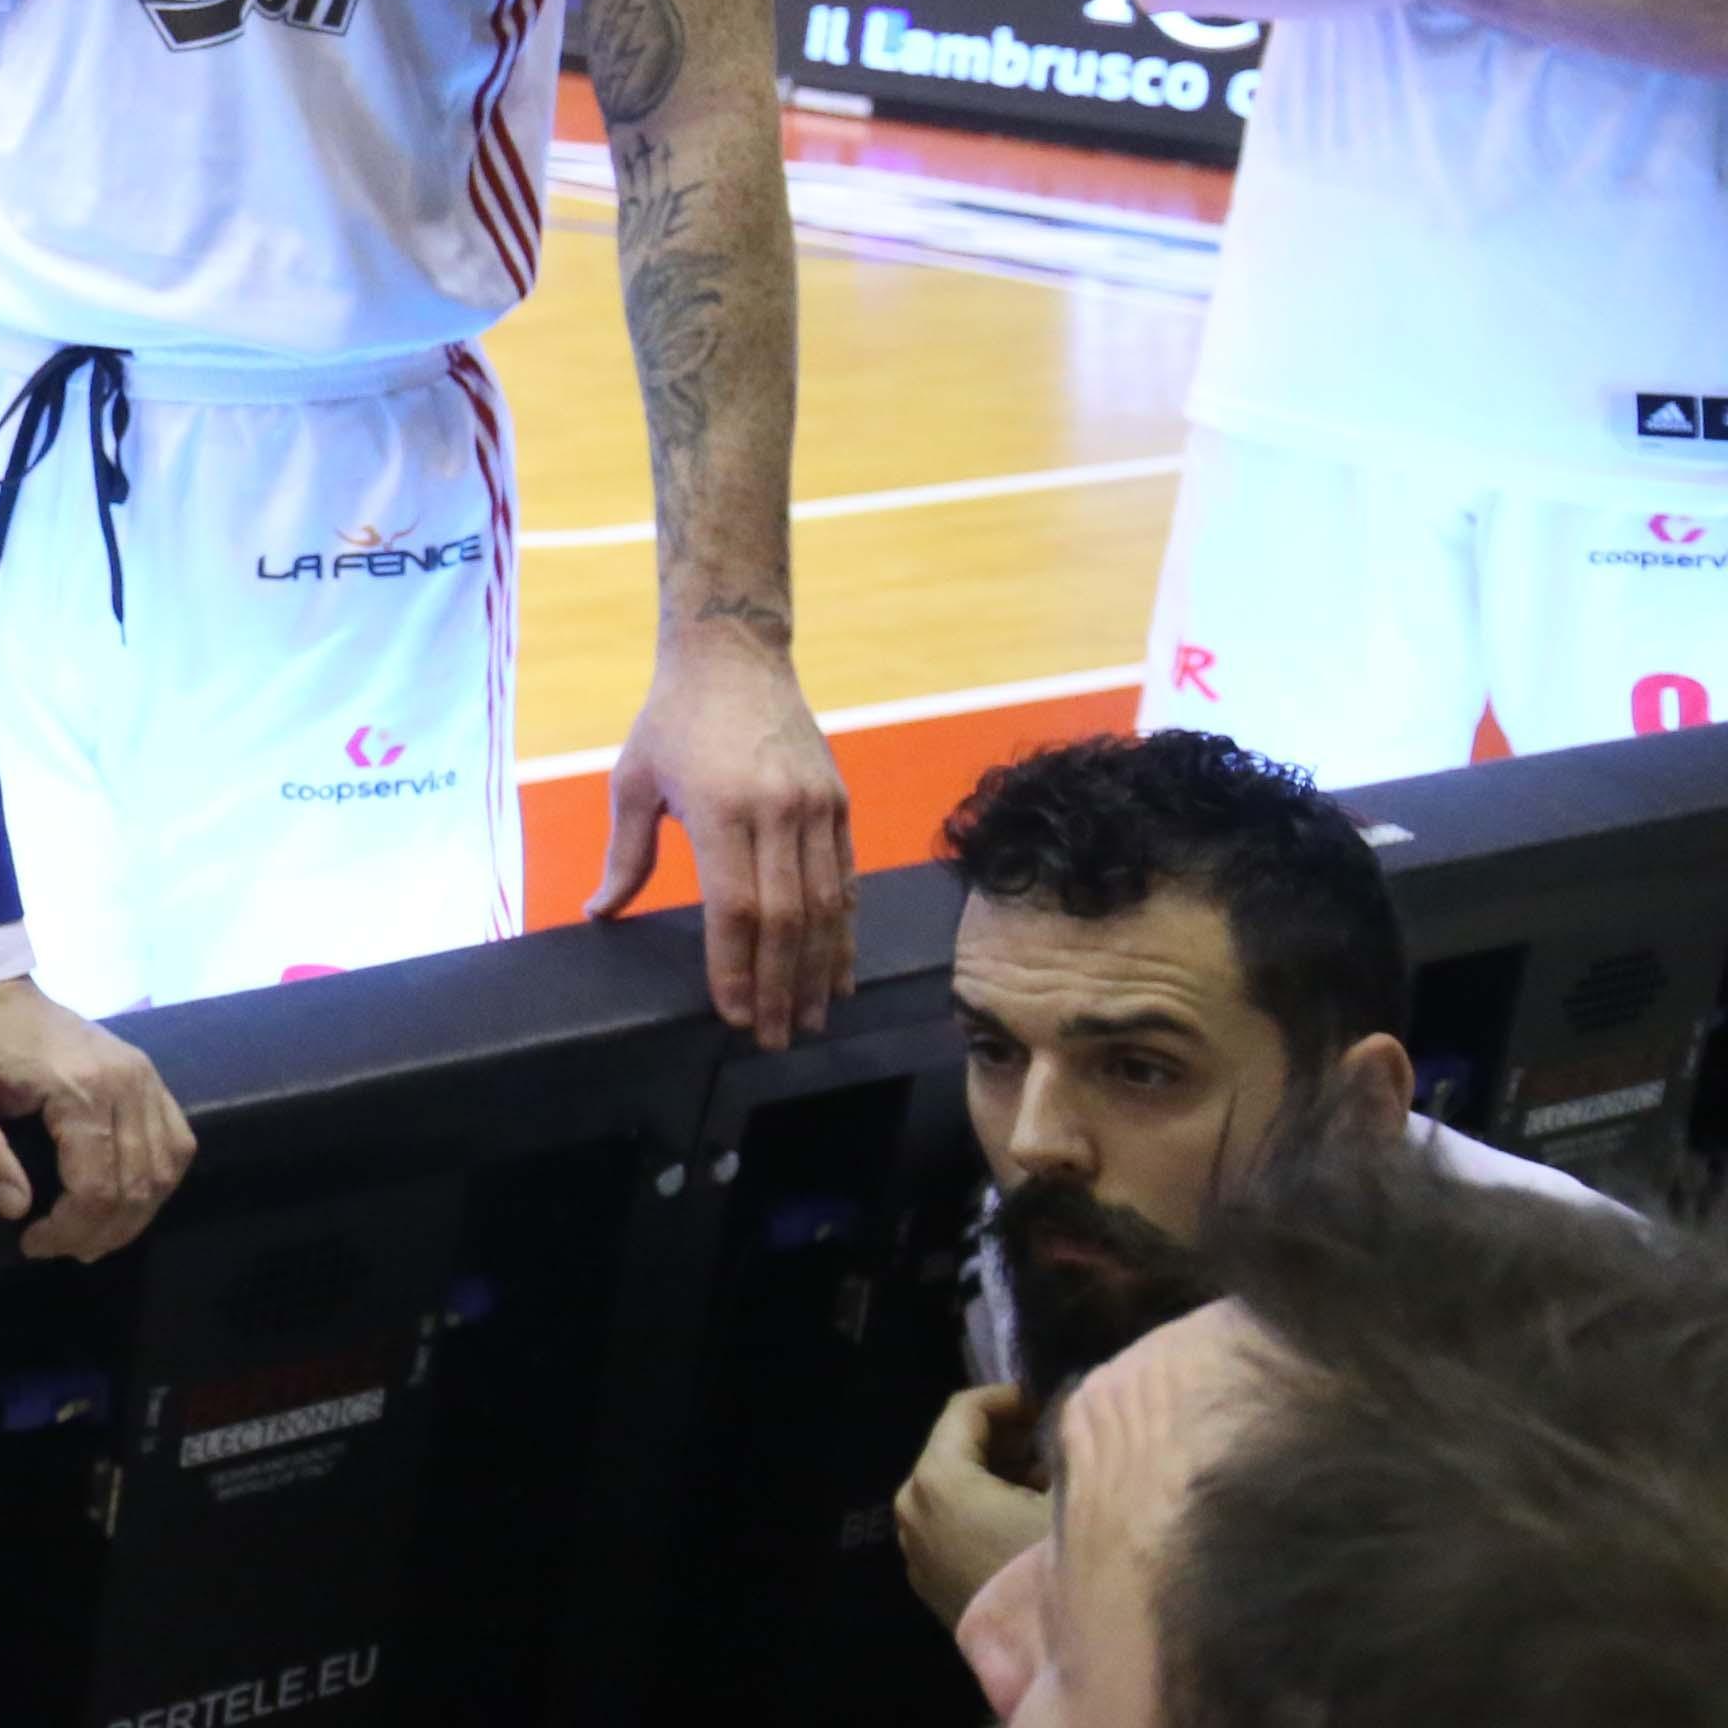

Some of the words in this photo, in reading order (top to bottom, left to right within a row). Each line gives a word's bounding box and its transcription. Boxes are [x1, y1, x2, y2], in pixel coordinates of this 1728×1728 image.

[861, 7, 1210, 112] Lambrusco
[257, 551, 323, 580] LA
[332, 533, 484, 578] FENICE
[280, 769, 456, 805] coopservice
